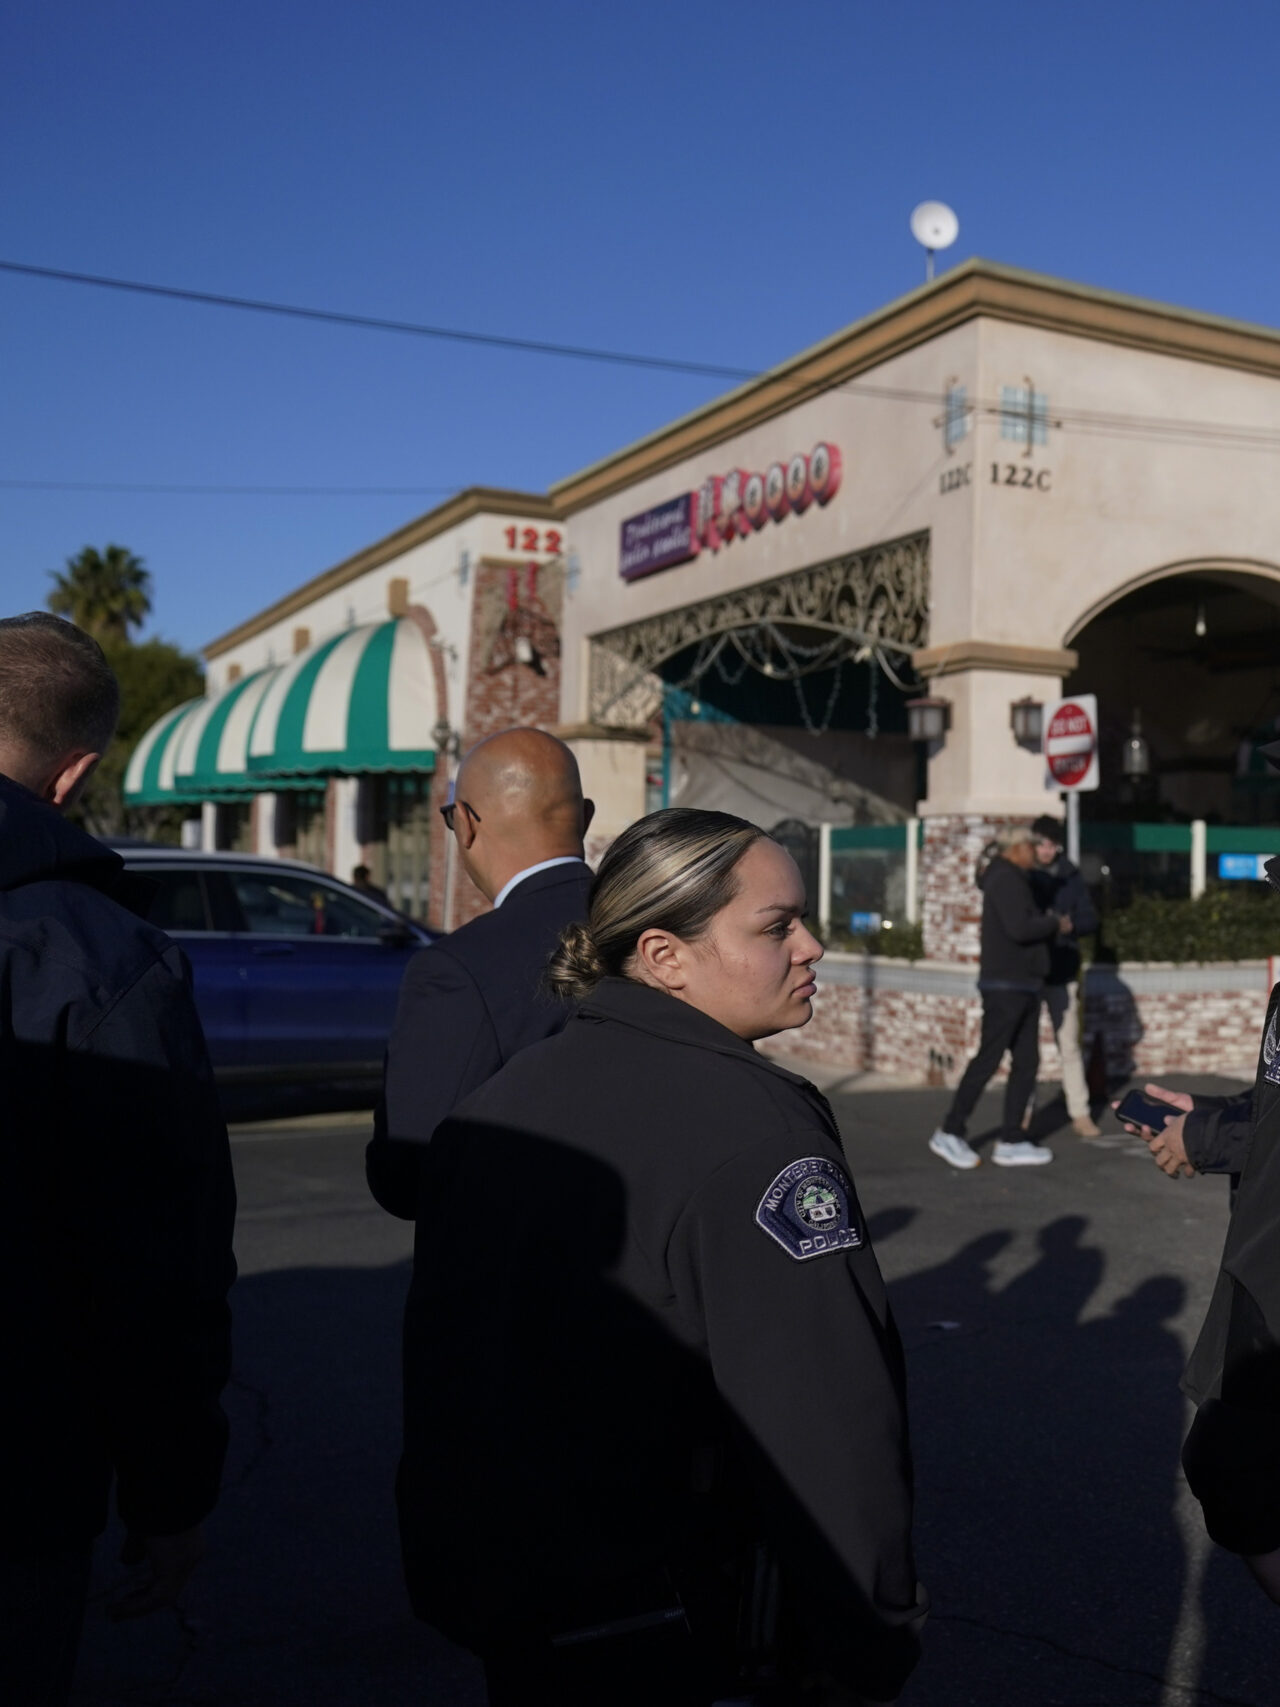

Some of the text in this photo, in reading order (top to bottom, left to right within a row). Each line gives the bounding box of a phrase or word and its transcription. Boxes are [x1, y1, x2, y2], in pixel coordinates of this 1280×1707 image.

[990, 461, 1052, 493] 122C
[503, 524, 563, 553] 122
[1051, 714, 1088, 736] DO NOT
[764, 1161, 826, 1211] MONTEREY
[798, 1227, 860, 1255] POLICE
